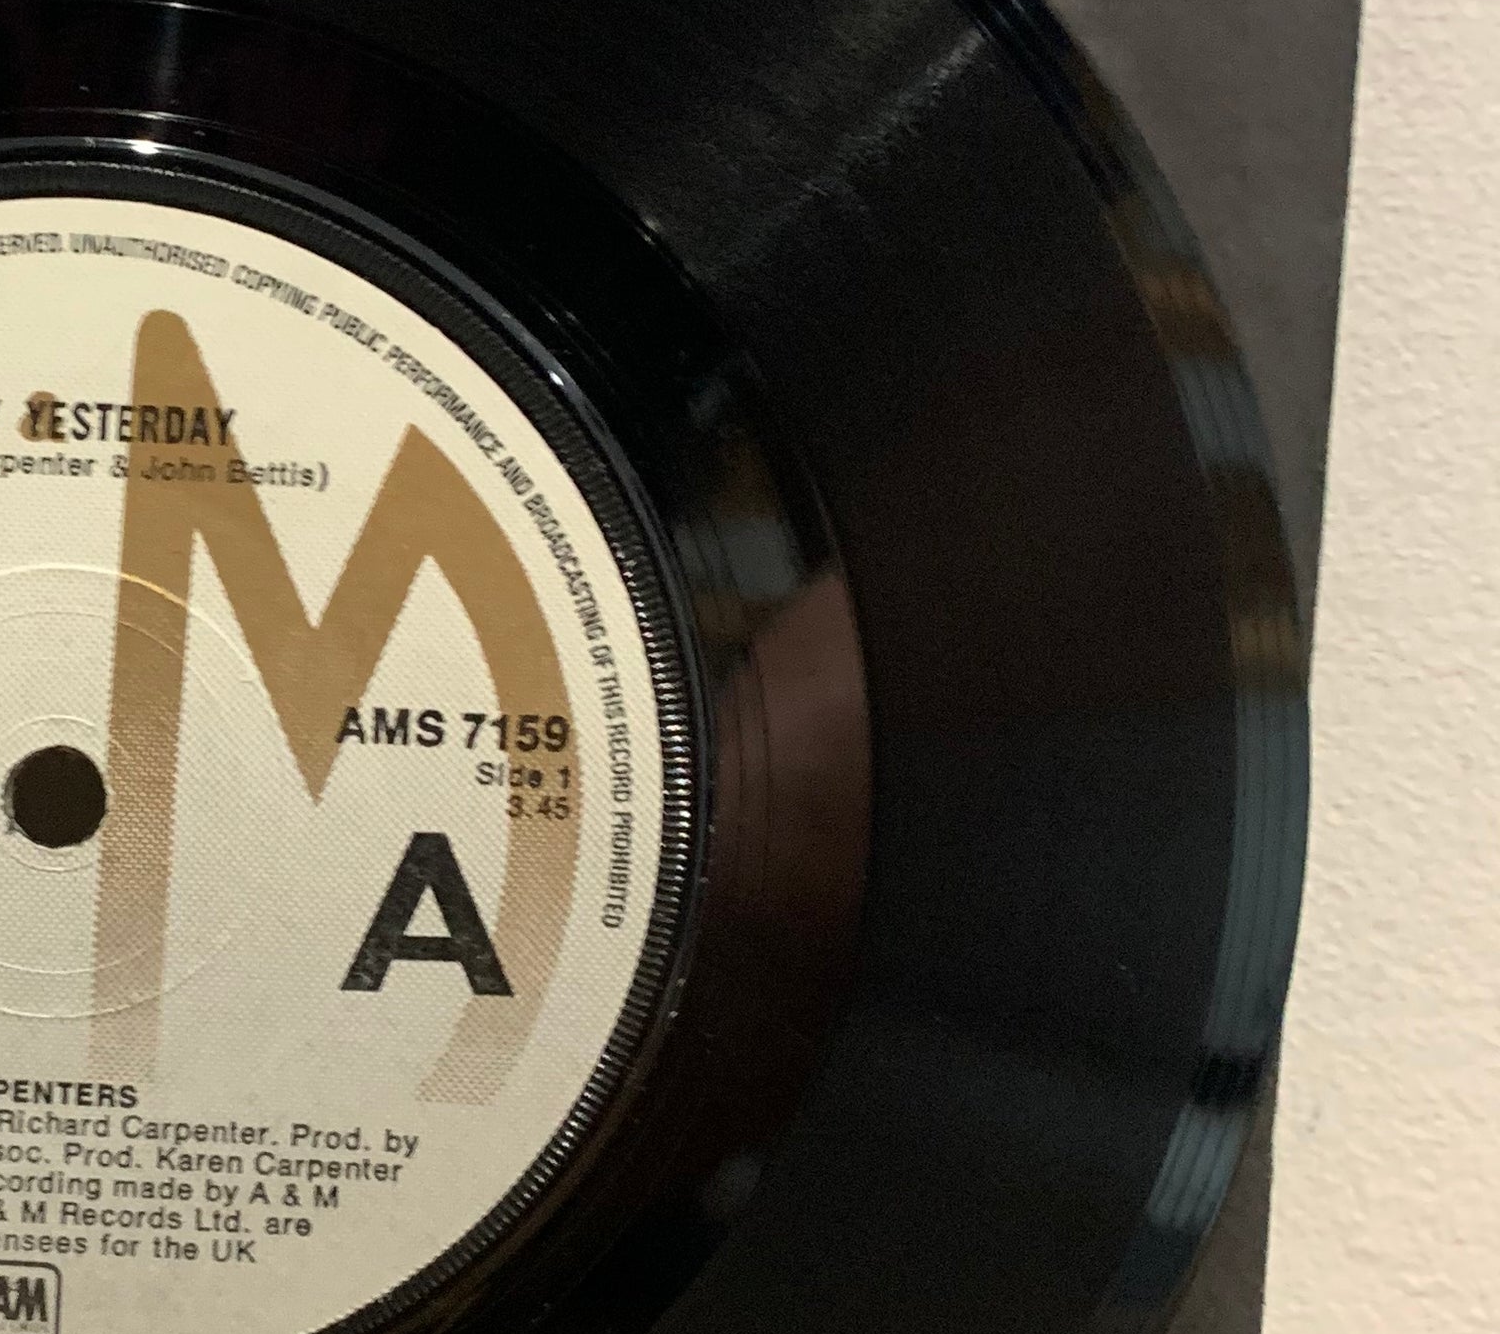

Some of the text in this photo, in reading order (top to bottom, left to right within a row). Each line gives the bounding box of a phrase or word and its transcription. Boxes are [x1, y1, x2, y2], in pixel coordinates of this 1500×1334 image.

[316, 302, 390, 353] PUBLIC
[26, 399, 237, 446] YESTERDAY
[382, 344, 506, 460] PERFORMANCE
[109, 454, 131, 479] &
[140, 455, 217, 482] John
[225, 458, 330, 493] Bettis)
[495, 455, 536, 497] AND
[522, 493, 607, 642] BROADCASTING
[591, 644, 616, 671] OF
[598, 671, 627, 720] THIS
[335, 706, 572, 753] AMS 7159
[475, 761, 571, 790] Side 1
[606, 721, 633, 803] RECORD
[506, 794, 571, 820] 3.45
[601, 811, 634, 930] PROHIBITED
[339, 831, 515, 998] A
[63, 1141, 143, 1170] Prod.
[156, 1145, 244, 1175] Karen
[254, 1150, 405, 1183] Carpenter
[290, 1123, 373, 1152] Prod.
[383, 1128, 420, 1159] by
[112, 1177, 193, 1202] made
[204, 1178, 239, 1207] by
[248, 1181, 272, 1206] A
[282, 1183, 303, 1207] &
[312, 1183, 341, 1209] M
[20, 1199, 47, 1225] M
[59, 1201, 183, 1230] Records
[195, 1207, 253, 1234] Ltd.
[264, 1214, 313, 1238] are
[100, 1232, 142, 1258] for
[152, 1235, 200, 1261] the
[211, 1238, 258, 1265] UK
